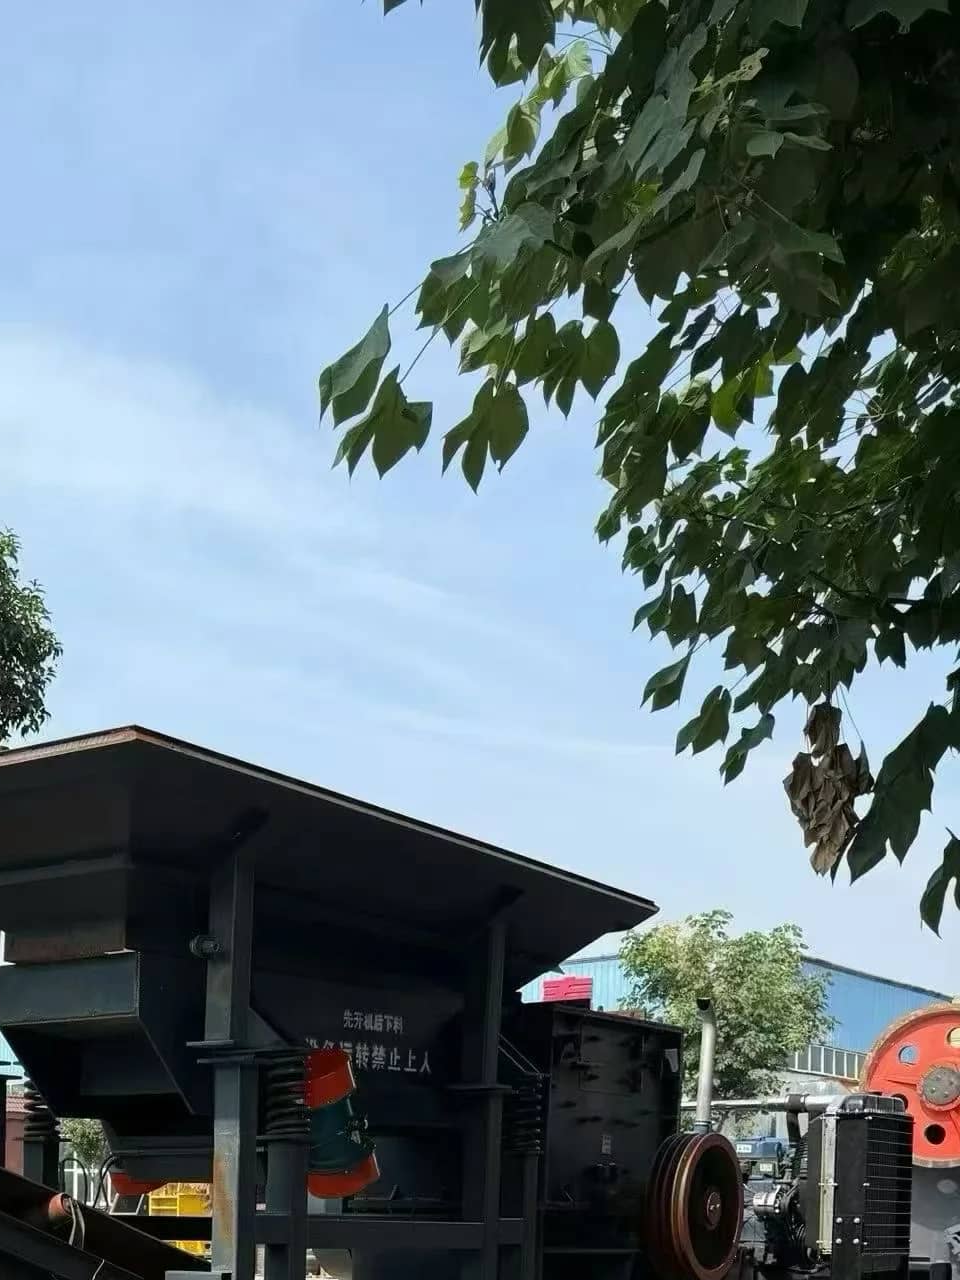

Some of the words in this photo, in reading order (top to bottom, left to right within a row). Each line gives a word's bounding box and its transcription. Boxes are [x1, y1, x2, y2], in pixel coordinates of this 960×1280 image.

[343, 1008, 403, 1035] 先开机后下料
